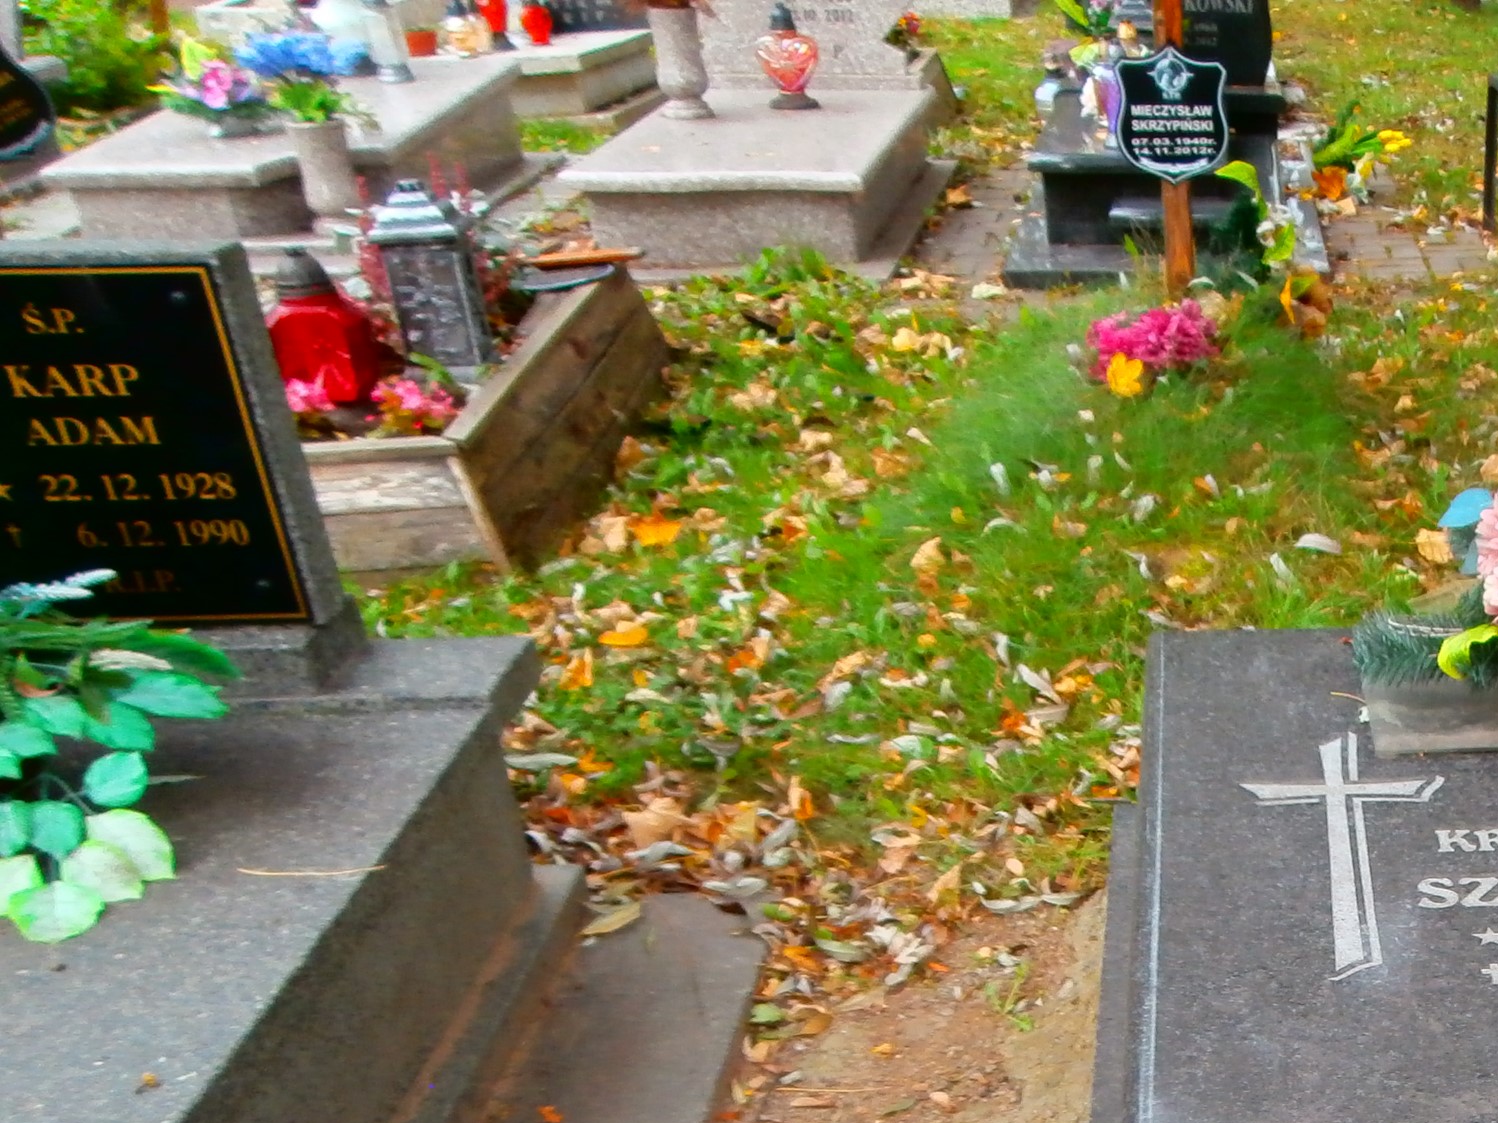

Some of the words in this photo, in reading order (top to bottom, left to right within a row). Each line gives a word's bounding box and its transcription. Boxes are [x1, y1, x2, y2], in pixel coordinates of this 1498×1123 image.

[1183, 0, 1255, 14] KOWSKI
[1130, 104, 1213, 117] MIECZYSŁAW
[1131, 118, 1215, 132] SKRZYPIŃSKI
[1132, 147, 1217, 156] 14.11.2012r.
[21, 302, 85, 334] Ś.P.
[2, 364, 139, 397] KARP
[28, 416, 161, 446] ADAM
[39, 474, 93, 501] 22.
[101, 474, 151, 501] 12.
[160, 472, 237, 500] 1928
[118, 520, 165, 547] 12.
[176, 519, 250, 547] 1990
